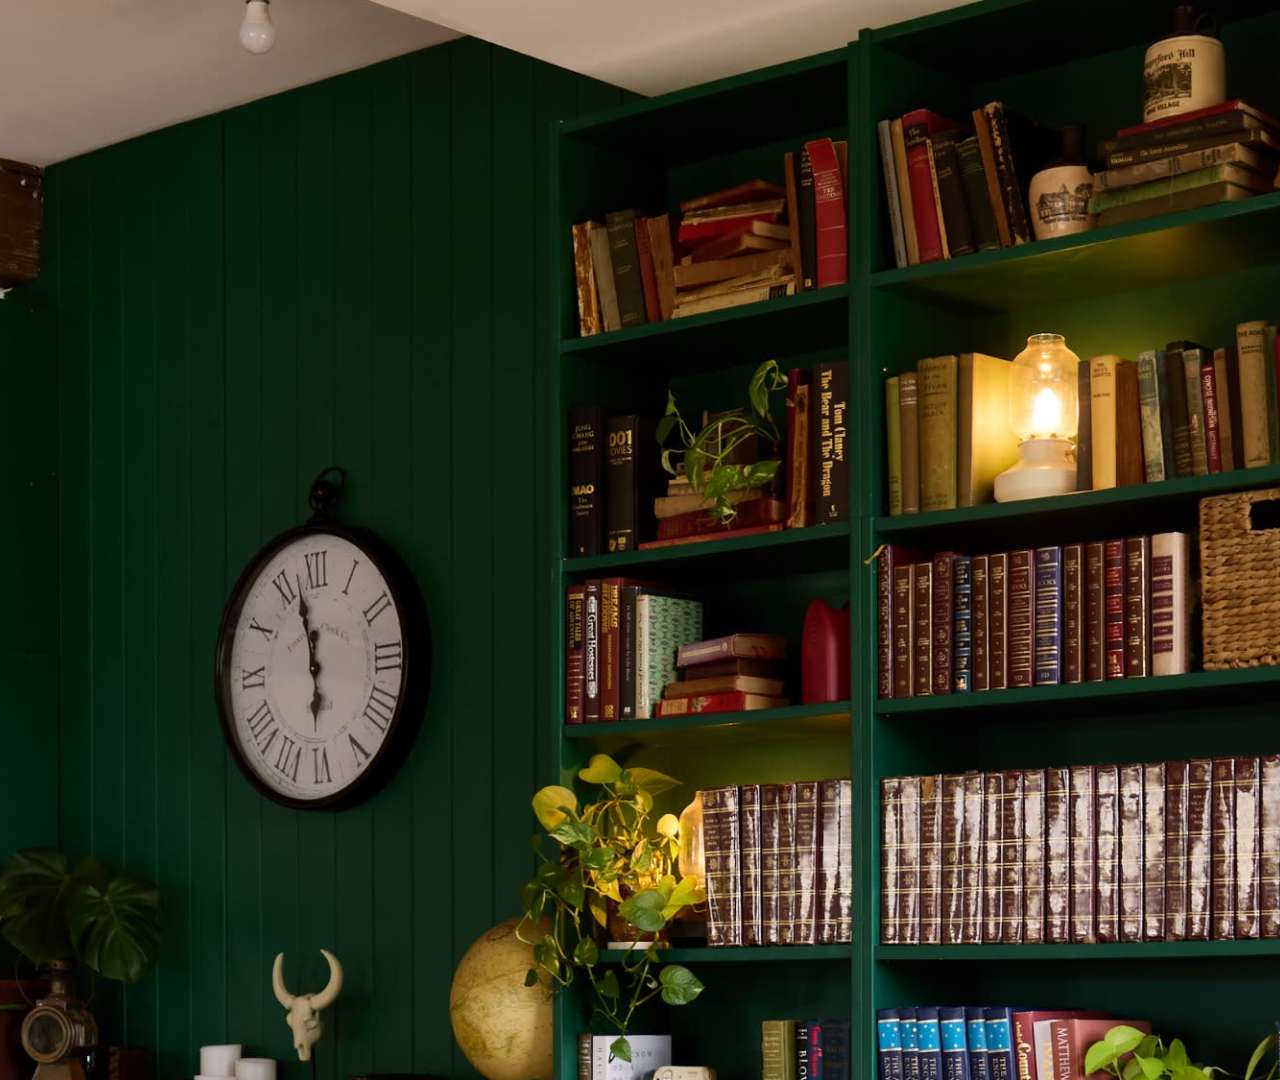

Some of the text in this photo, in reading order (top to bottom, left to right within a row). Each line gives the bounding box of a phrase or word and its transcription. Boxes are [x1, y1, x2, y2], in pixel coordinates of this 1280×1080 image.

[820, 369, 834, 497] The Bear and The Dragon
[833, 401, 846, 462] Tom Clancy
[272, 569, 297, 610] XI
[304, 551, 328, 590] XII
[342, 560, 360, 595] I
[363, 591, 393, 626] II
[249, 617, 273, 642] X
[375, 641, 402, 674] III
[242, 667, 266, 690] IX
[247, 700, 279, 755] VIII
[363, 686, 397, 733] IIII
[275, 735, 302, 782] VII
[312, 747, 332, 784] VI
[348, 733, 372, 767] V
